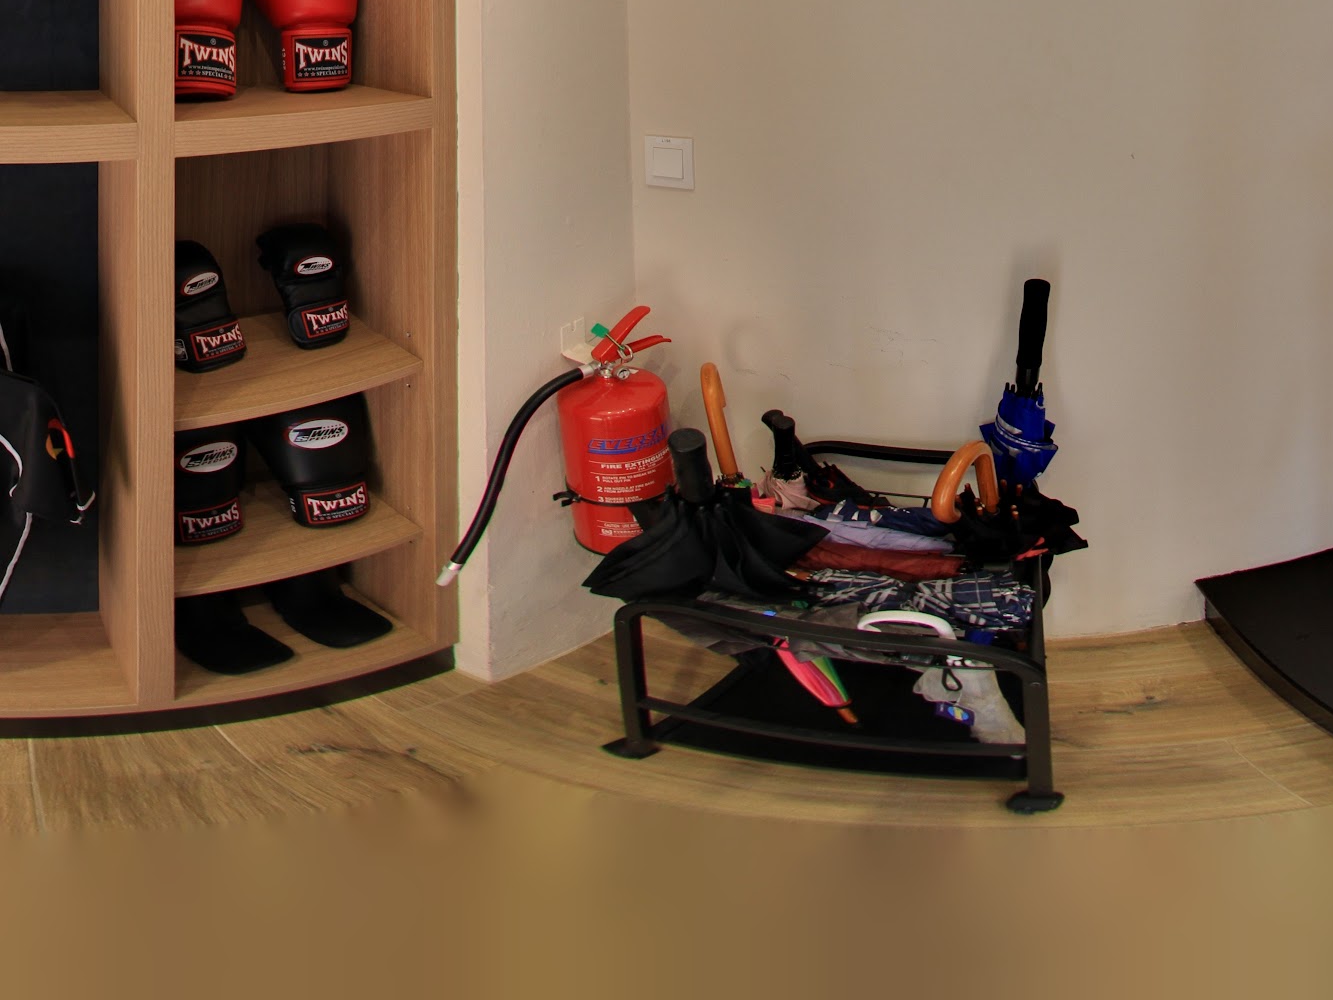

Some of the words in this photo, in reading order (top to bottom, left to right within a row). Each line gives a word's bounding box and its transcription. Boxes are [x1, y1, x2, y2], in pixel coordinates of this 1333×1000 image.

[180, 37, 235, 73] TWINS
[295, 39, 348, 70] TWINS
[316, 69, 337, 77] SPECIAL
[306, 303, 348, 331] TWINS
[195, 323, 243, 354] TWINS
[293, 426, 344, 442] TWINS
[185, 447, 235, 467] TWINS
[307, 486, 367, 516] TWINS
[182, 502, 240, 534] TWINS
